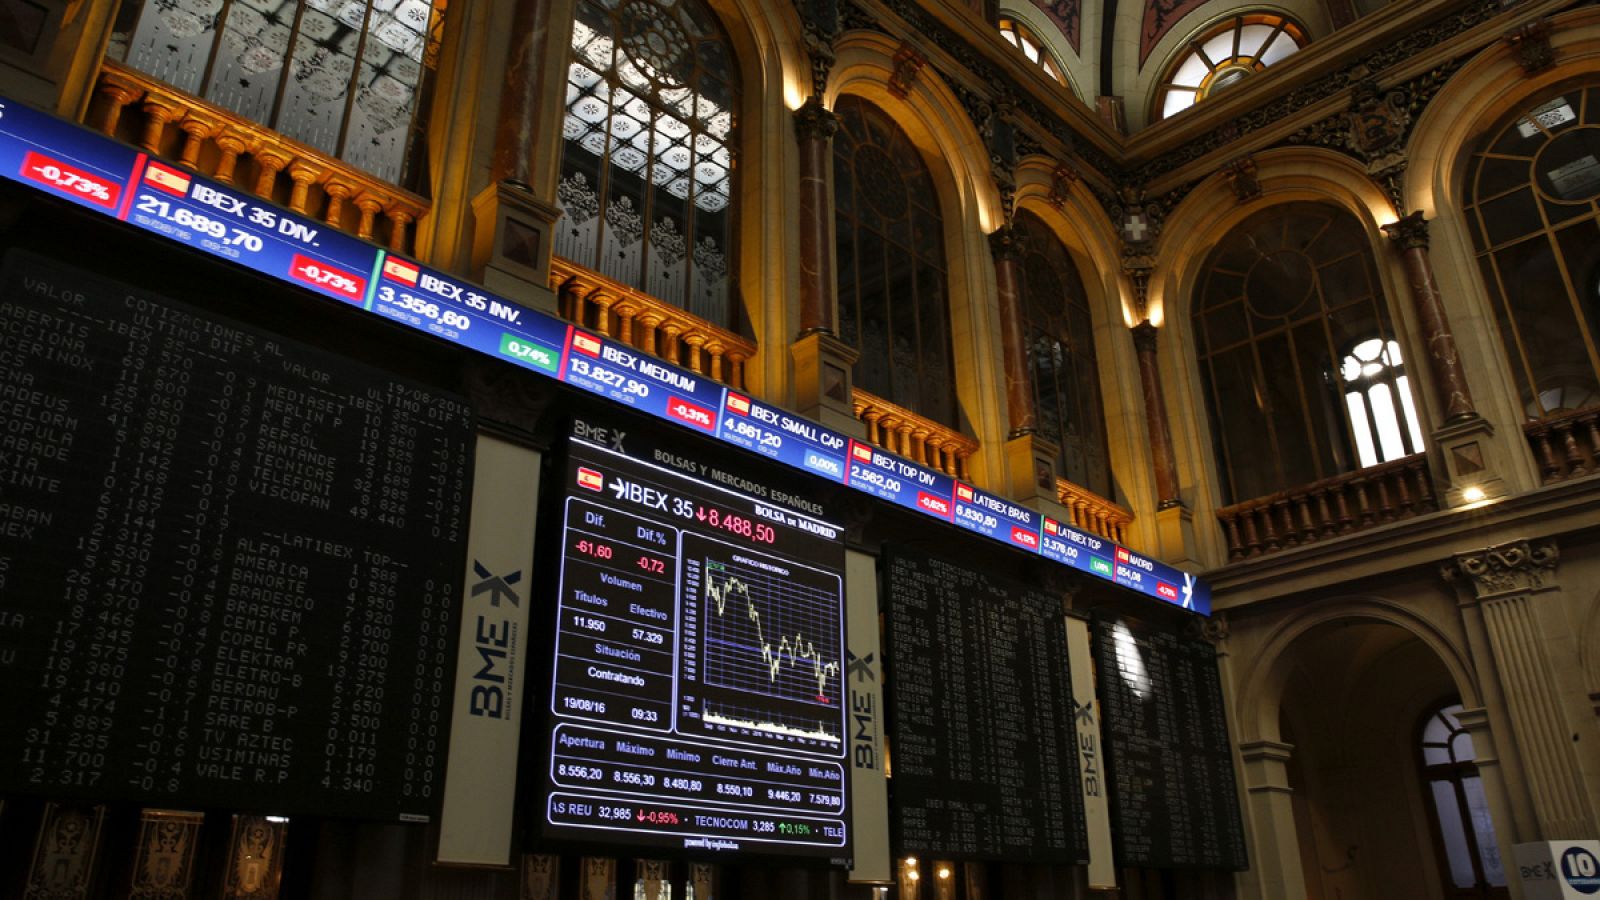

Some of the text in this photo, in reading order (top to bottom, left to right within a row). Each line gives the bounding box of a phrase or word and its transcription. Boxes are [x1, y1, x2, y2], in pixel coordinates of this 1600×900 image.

[32, 166, 109, 200] -0,73%
[136, 195, 263, 252] 21.689,70
[191, 184, 319, 247] IBEX 35 DIV.
[24, 277, 85, 306] VALOR
[298, 266, 357, 293] -0,73%
[378, 286, 470, 330] 3.356,60
[420, 274, 521, 325] IBEX 35 INV.
[0, 303, 89, 338] ABERTIS
[125, 295, 283, 356] COTIZACIONES AL
[132, 312, 241, 354] ULTIMO DIF
[508, 341, 550, 365] 0,74%
[283, 360, 330, 384] VALOR
[570, 358, 649, 397] 13.827,90
[602, 346, 637, 370] IBEX
[639, 360, 695, 392] MEDIUM
[265, 397, 324, 423] MERLIN
[267, 384, 345, 415] MEDIASET
[367, 388, 453, 421] ULTIMO DIF
[387, 382, 470, 416] 19/08/2016
[673, 405, 710, 425] -0,31%
[751, 405, 844, 449] IBEX SMALL CAP
[259, 424, 317, 450] REPSOL
[256, 451, 334, 482] TECNICAS
[257, 438, 336, 468] SANTANDE
[808, 453, 839, 474] 0,00%
[253, 465, 330, 496] TELEFONI
[654, 449, 696, 472] BOLSAS
[700, 464, 707, 476] Y
[712, 469, 767, 496] MERCADOS
[771, 489, 823, 516] ESPAÑOLES
[873, 453, 935, 486] IBEX TOP DIV
[249, 480, 330, 510] VISCOFAN
[974, 492, 1030, 523] LATIBEX BRAS
[622, 481, 775, 544] IBEX 35 8.488,50
[755, 504, 786, 523] BOLSA
[798, 518, 836, 539] MADRID
[585, 512, 666, 545] Dif. Dif.%
[1058, 526, 1101, 550] LATIBEX TOP
[237, 538, 280, 557] ALFA
[576, 540, 664, 574] -61,60 -0,72
[235, 553, 308, 579] AMERICA
[1129, 555, 1153, 571] MADRID
[232, 568, 306, 594] BANORTE
[600, 573, 642, 592] Volumen
[229, 583, 314, 610] BRADESCO
[574, 590, 667, 620] Títulos Efectivo
[224, 614, 277, 635] CEMIG
[226, 599, 301, 624] BRASKEM
[220, 630, 307, 656] COPEL PR
[574, 616, 663, 644] 11.950 57.329
[217, 646, 294, 669] ELEKTRA
[595, 643, 640, 662] Situación
[214, 662, 302, 687] ELETRO-B
[507, 657, 515, 691] MERCADOS
[588, 666, 645, 686] Contratando
[211, 679, 279, 700] GERDAU
[208, 695, 298, 718] PETROB-P
[504, 697, 513, 720] BOLSAS
[564, 697, 658, 722] 19/08/16 09:33
[205, 712, 273, 732] SARE B
[203, 728, 292, 751] TV AZTEC
[559, 733, 605, 749] Apertura
[616, 741, 655, 756] Máximo
[666, 748, 700, 762] Mínimo
[712, 755, 739, 767] Cierre
[740, 759, 757, 770] Ant.
[199, 746, 291, 768] USIMINAS
[196, 763, 243, 780] VALE
[558, 764, 603, 780] 8.556,20
[613, 771, 655, 786] 8.556,30
[716, 783, 753, 796] 8.550,10
[568, 803, 592, 816] REU
[598, 806, 631, 820] 32,985
[645, 811, 679, 824] -0,95%
[695, 816, 748, 829] TECNOCOM
[753, 820, 775, 832] 3,285
[785, 824, 810, 834] 0,15%
[823, 826, 842, 839] TELE
[1567, 852, 1596, 877] 10
